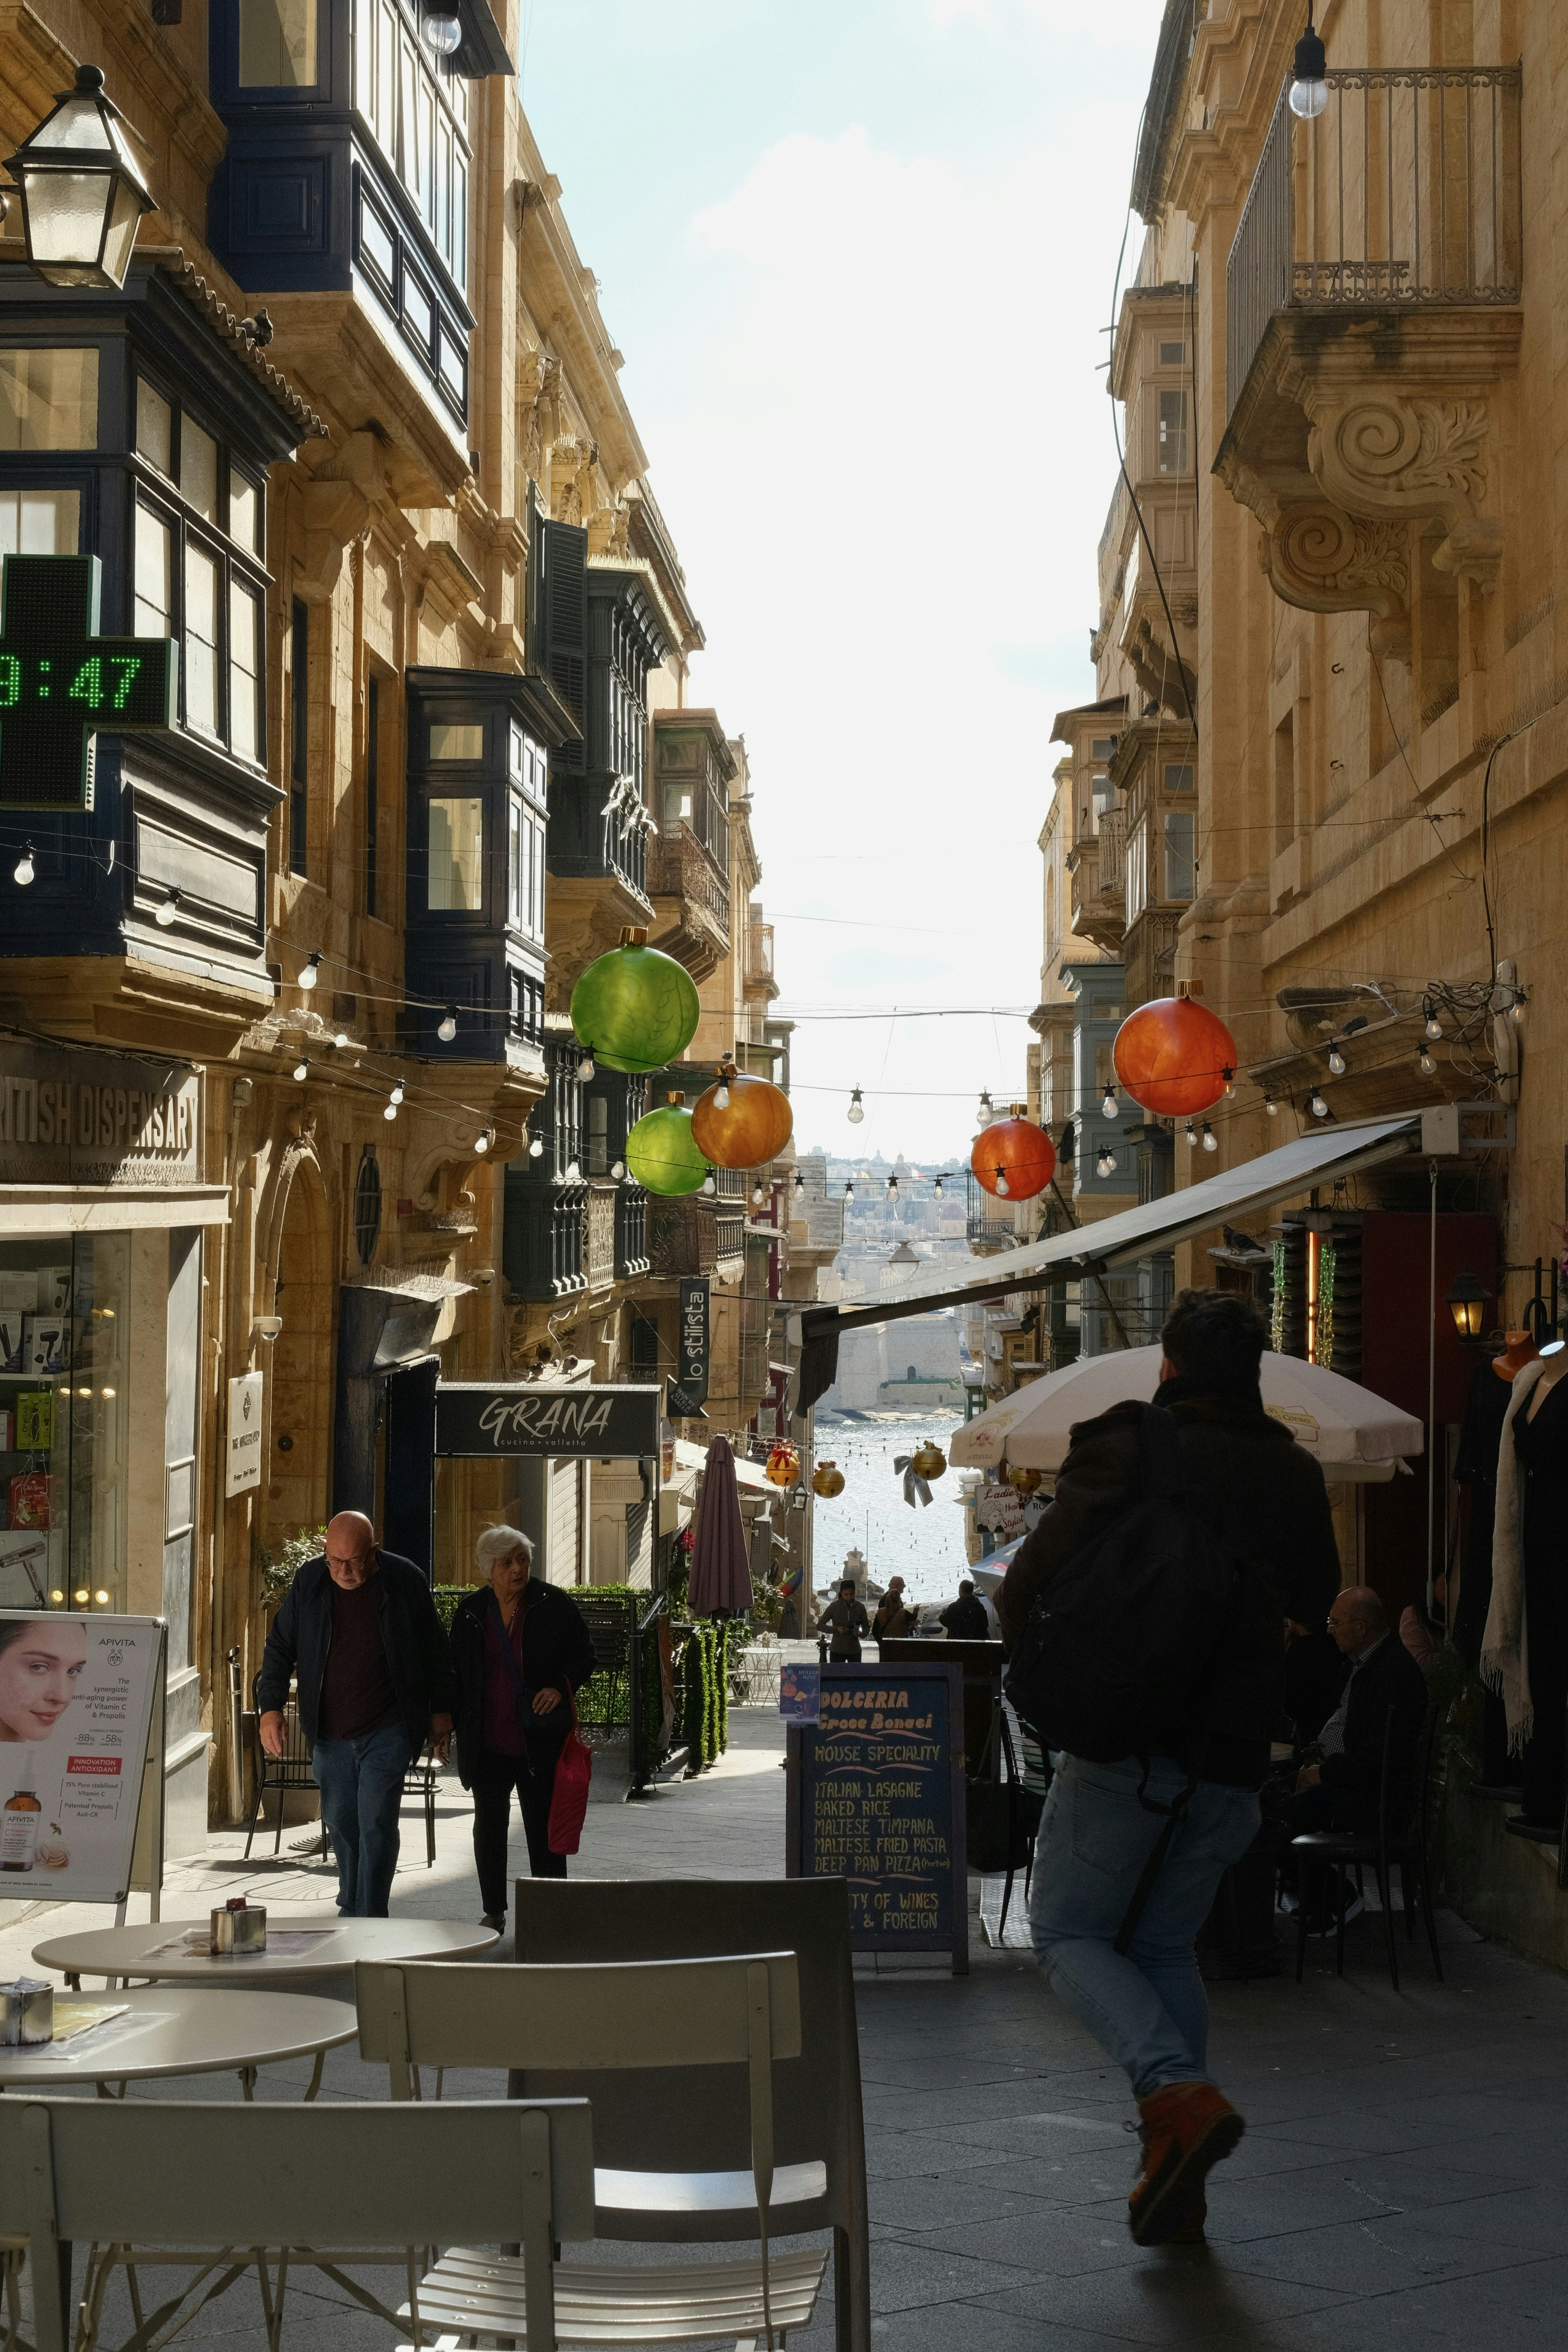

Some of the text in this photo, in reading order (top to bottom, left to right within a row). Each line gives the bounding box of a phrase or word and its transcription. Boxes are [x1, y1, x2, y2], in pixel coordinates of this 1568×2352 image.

[0, 1075, 198, 1149] ITISH DISPENSARY
[684, 1292, 704, 1380] lo stilista
[677, 1388, 689, 1400] HAIR
[479, 1394, 614, 1447] GRANA
[1283, 1414, 1310, 1424] Corso
[1003, 1515, 1024, 1530] Stylist
[820, 1690, 908, 1708] DOLCERIA
[817, 1713, 933, 1730] Croce Bonaci
[74, 1734, 122, 1743] -88% -58%
[814, 1744, 941, 1762] HOUSE SPECIALITY
[868, 1782, 922, 1798] LASAGNE
[815, 1801, 891, 1816] BAKED RICE
[814, 1819, 935, 1835] MALTESE TIMPANA
[814, 1837, 947, 1854] MALTESE FRIED PASTA
[815, 1856, 847, 1872] DEEP
[855, 1856, 879, 1872] PAN
[886, 1856, 921, 1872] PIZZA
[874, 1893, 891, 1909] OF
[899, 1893, 939, 1909] WINES
[863, 1911, 937, 1929] & FOREIGN
